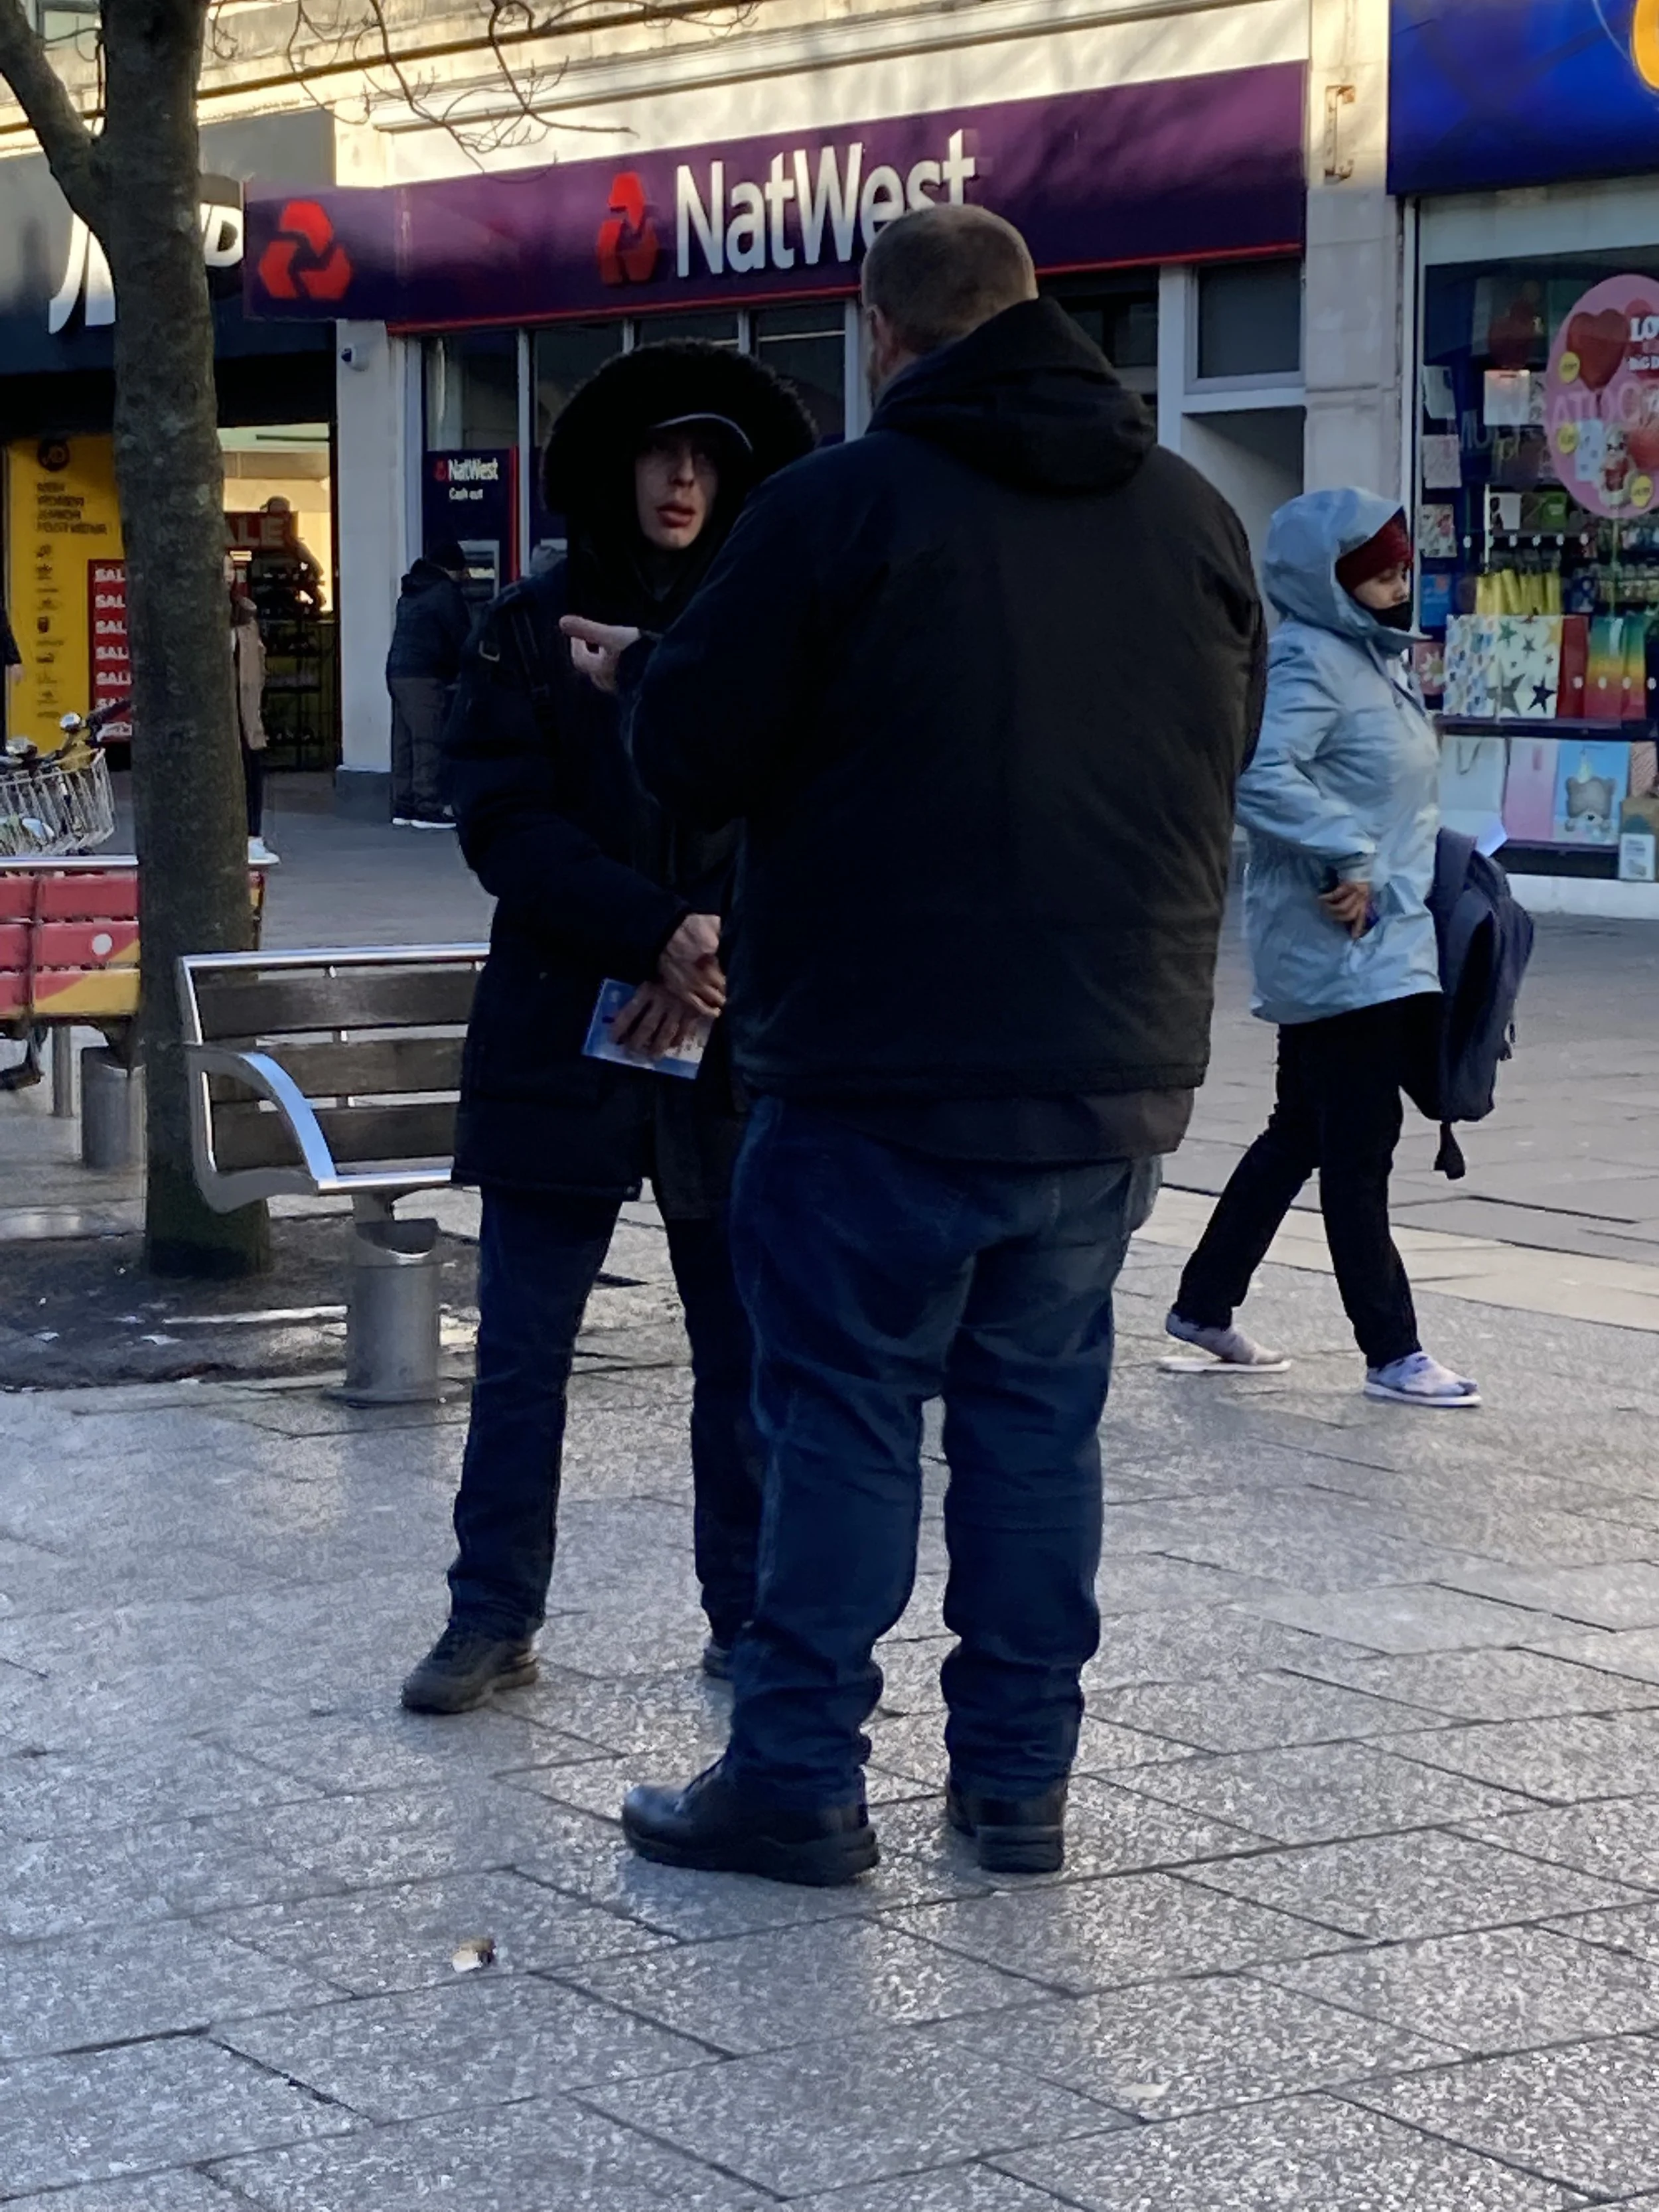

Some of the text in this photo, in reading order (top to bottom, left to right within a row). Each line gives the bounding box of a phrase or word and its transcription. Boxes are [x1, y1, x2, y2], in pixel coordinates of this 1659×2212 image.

[447, 457, 498, 481] NatWest
[95, 568, 126, 582] SAL
[95, 594, 126, 608] SAL
[96, 620, 127, 634] SAL
[96, 646, 129, 659] SAL
